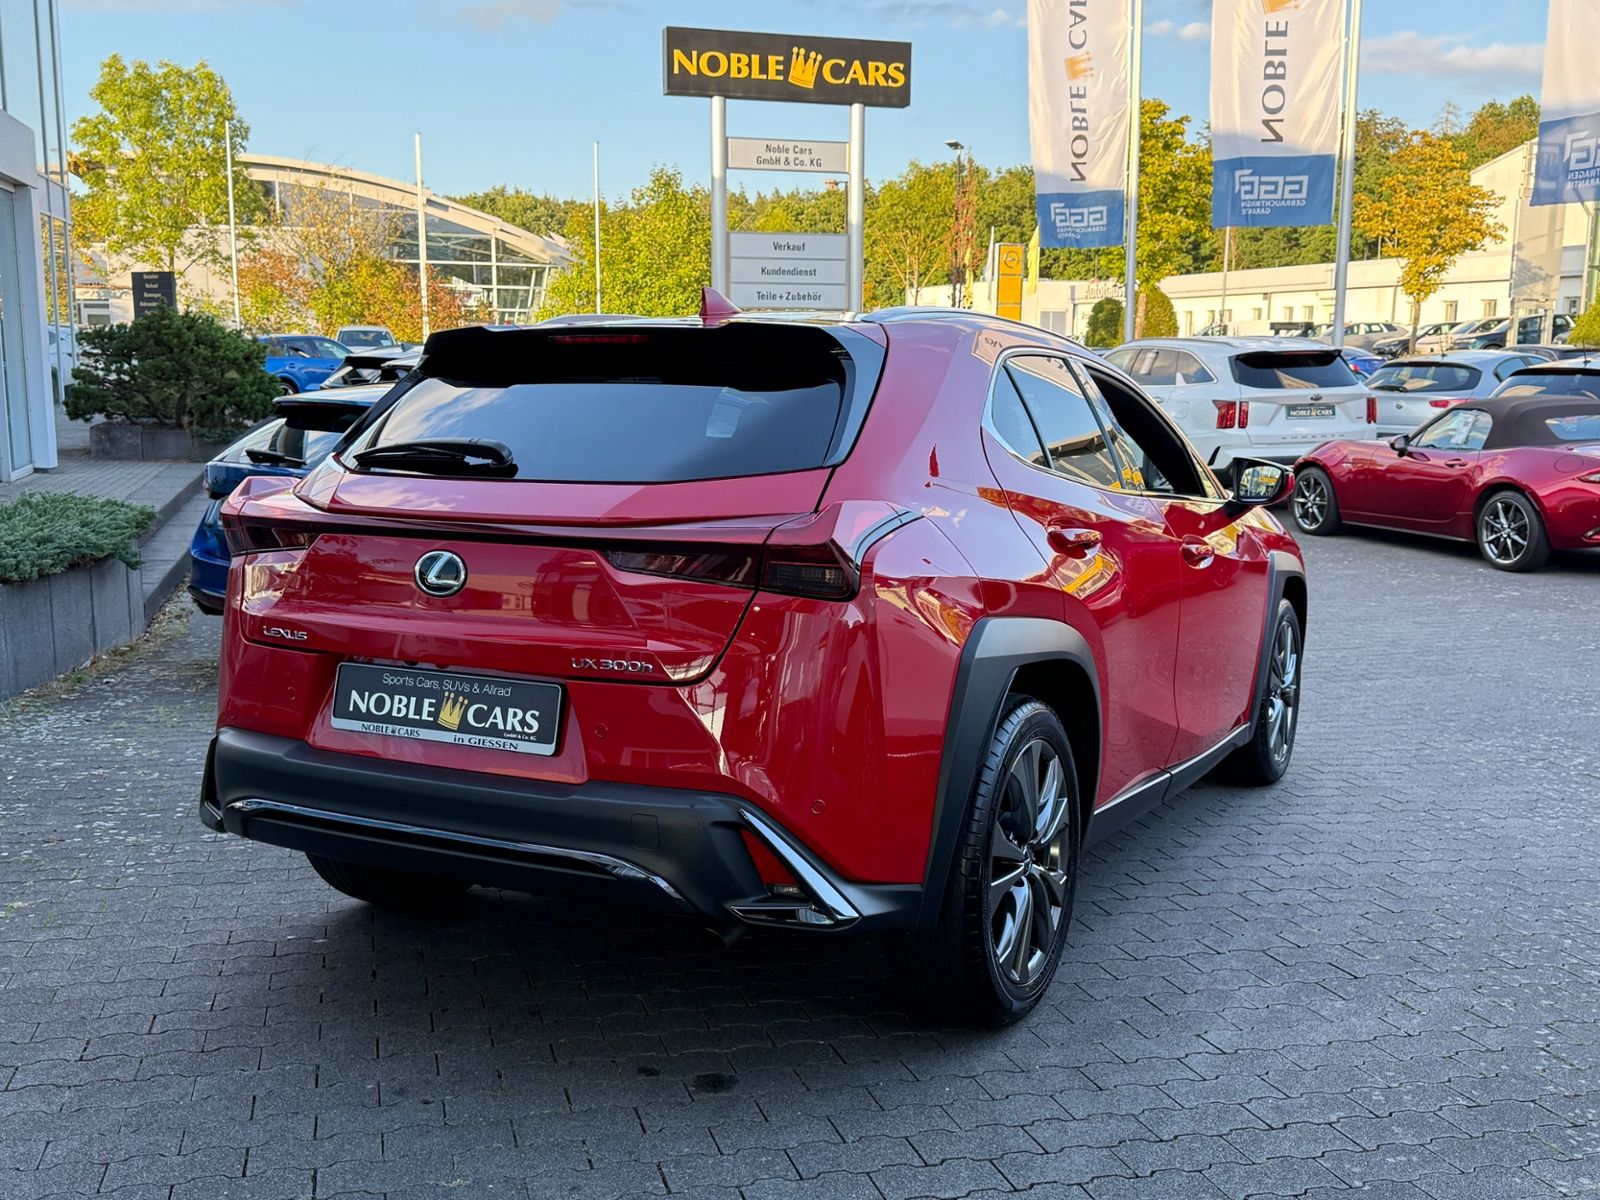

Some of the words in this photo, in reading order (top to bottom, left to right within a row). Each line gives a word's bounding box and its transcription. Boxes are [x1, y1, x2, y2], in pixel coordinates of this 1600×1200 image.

[673, 49, 785, 81] NOBLE
[822, 58, 906, 88] CARS
[765, 144, 790, 155] Noble
[793, 145, 813, 155] Cars
[756, 156, 781, 166] GmbH
[783, 157, 790, 166] &
[793, 157, 807, 167] Co.
[809, 158, 822, 167] KG
[772, 241, 806, 252] Verkauf
[760, 266, 817, 277] Kundendienst
[262, 625, 308, 641] LEXUS
[571, 657, 598, 670] UX
[599, 659, 653, 673] 300h
[382, 672, 415, 687] Sports
[416, 676, 441, 690] Cars,
[442, 679, 470, 693] SUVs
[472, 682, 481, 694] &
[481, 684, 512, 697] Allrad
[348, 689, 436, 722] NOBLE
[466, 703, 540, 734] CARS
[361, 723, 390, 734] NOBLE
[397, 727, 421, 737] CARS
[453, 734, 465, 744] in
[468, 736, 519, 750] GIESSEN
